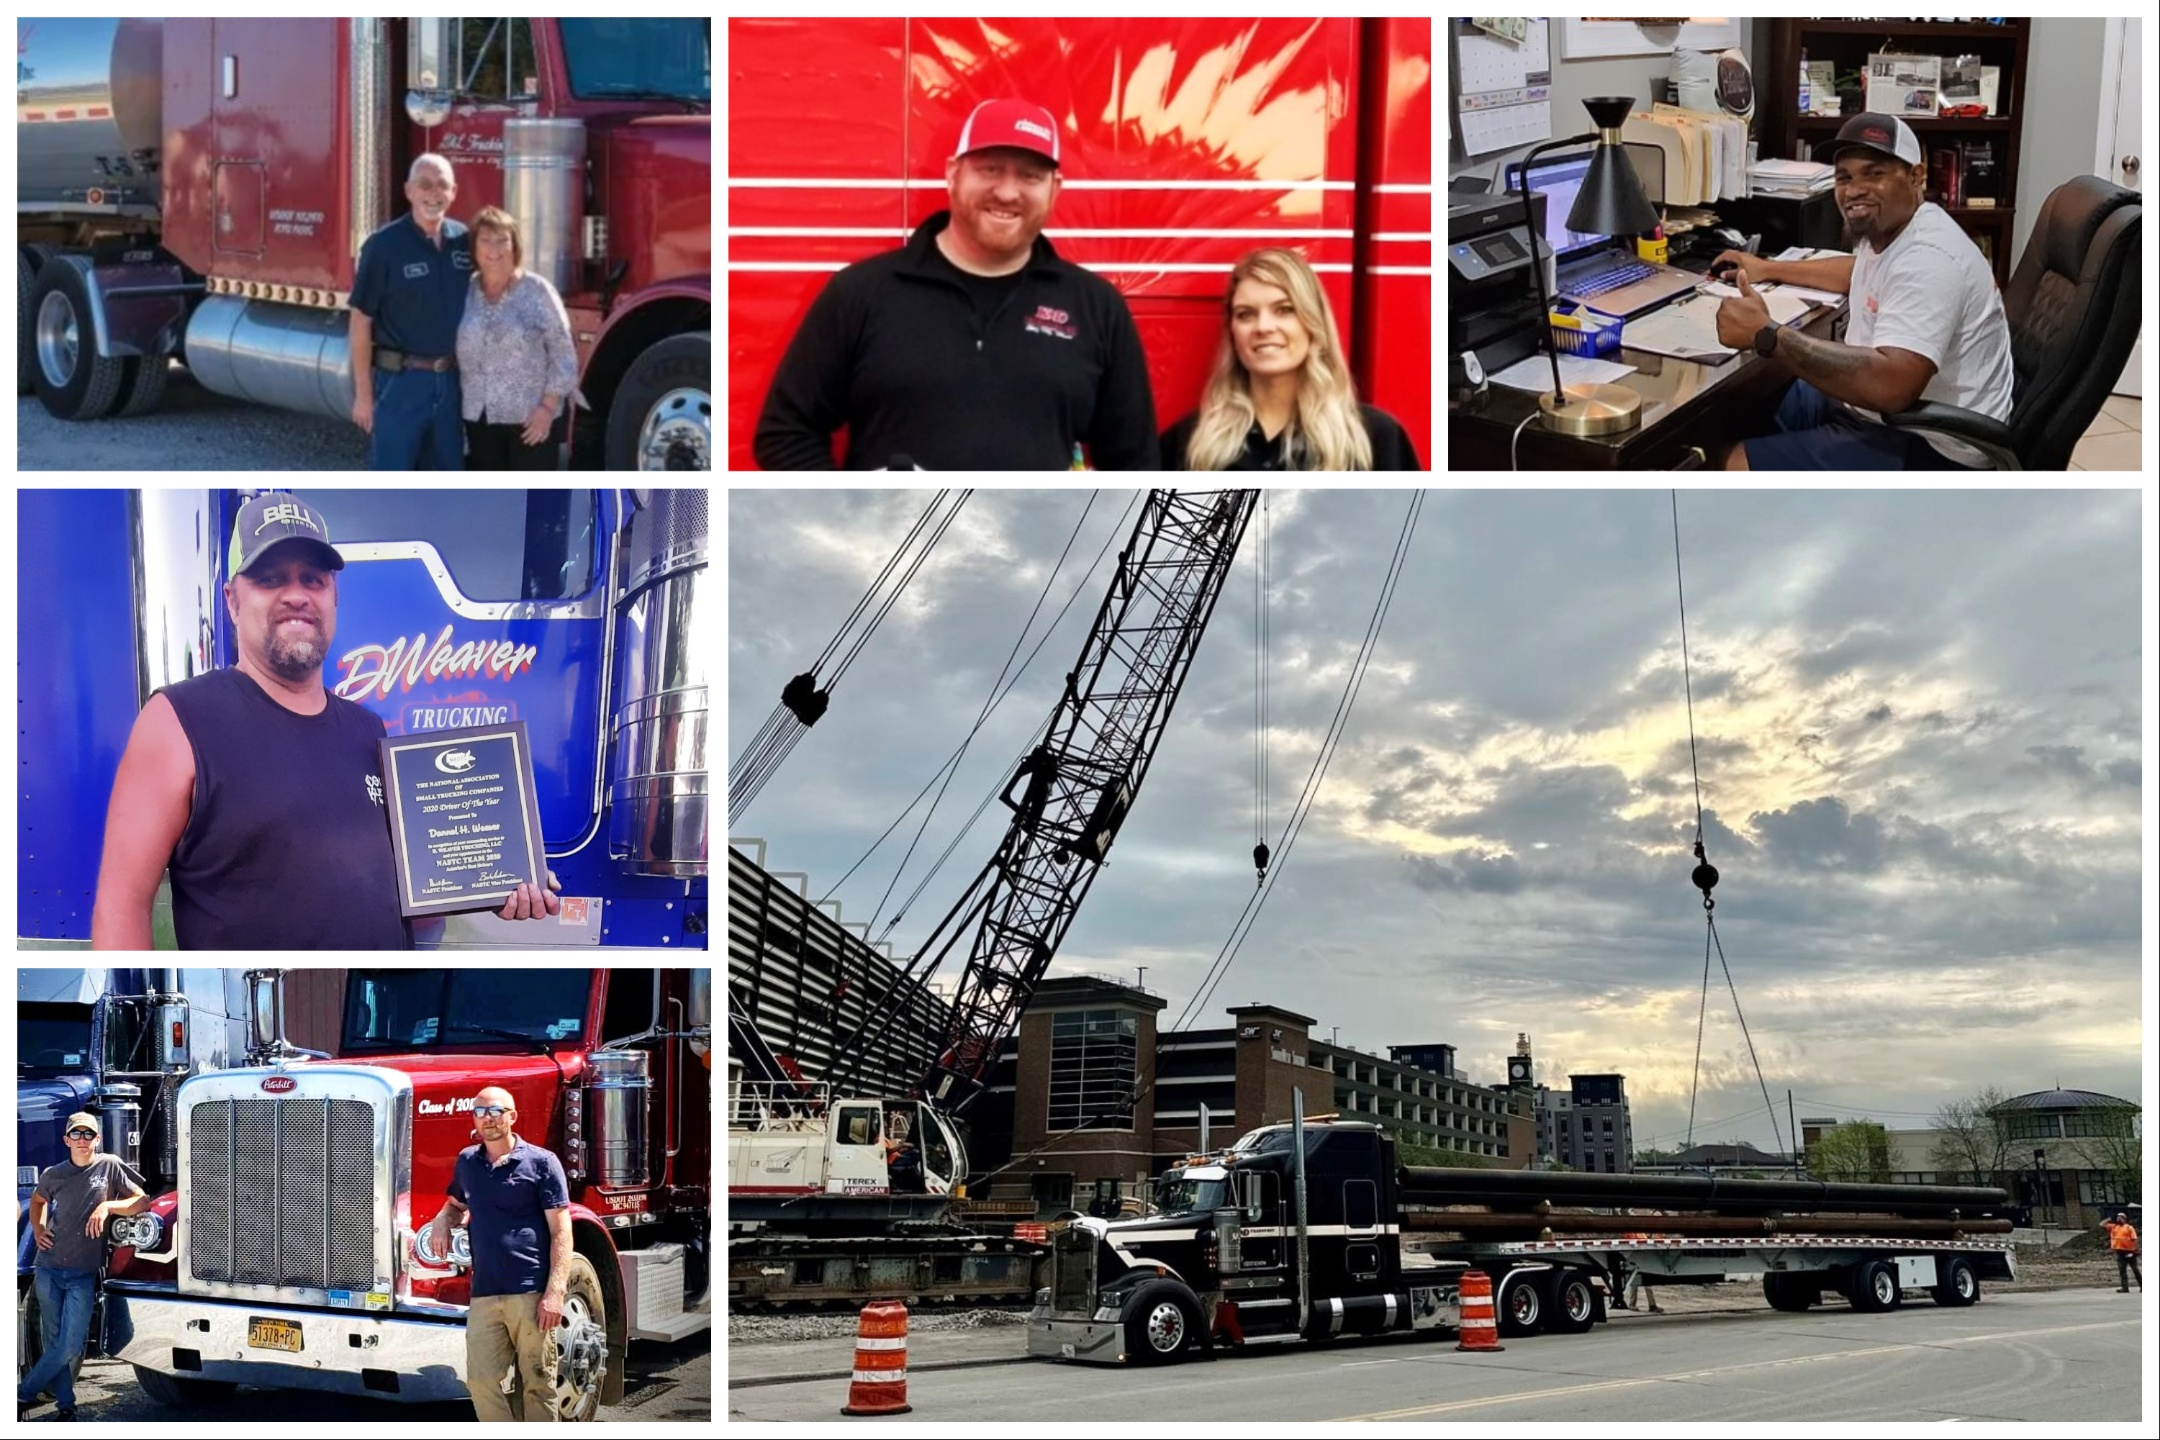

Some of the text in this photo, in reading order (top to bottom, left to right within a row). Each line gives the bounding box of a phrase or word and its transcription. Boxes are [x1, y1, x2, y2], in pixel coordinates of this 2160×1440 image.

[411, 706, 508, 729] TRUCKING
[429, 779, 460, 788] NATIONAL
[460, 774, 500, 783] ASSOCIATION
[436, 790, 468, 799] TRUCKING
[469, 786, 504, 795] COMPANIES
[422, 804, 438, 813] 2020
[439, 802, 461, 812] Driver
[484, 797, 500, 806] Year
[436, 857, 462, 867] NASTC
[463, 855, 485, 864] TEAM
[418, 1098, 444, 1115] Class
[444, 1097, 456, 1116] of
[845, 1186, 886, 1195] AMERICAN
[251, 1324, 280, 1344] 51378
